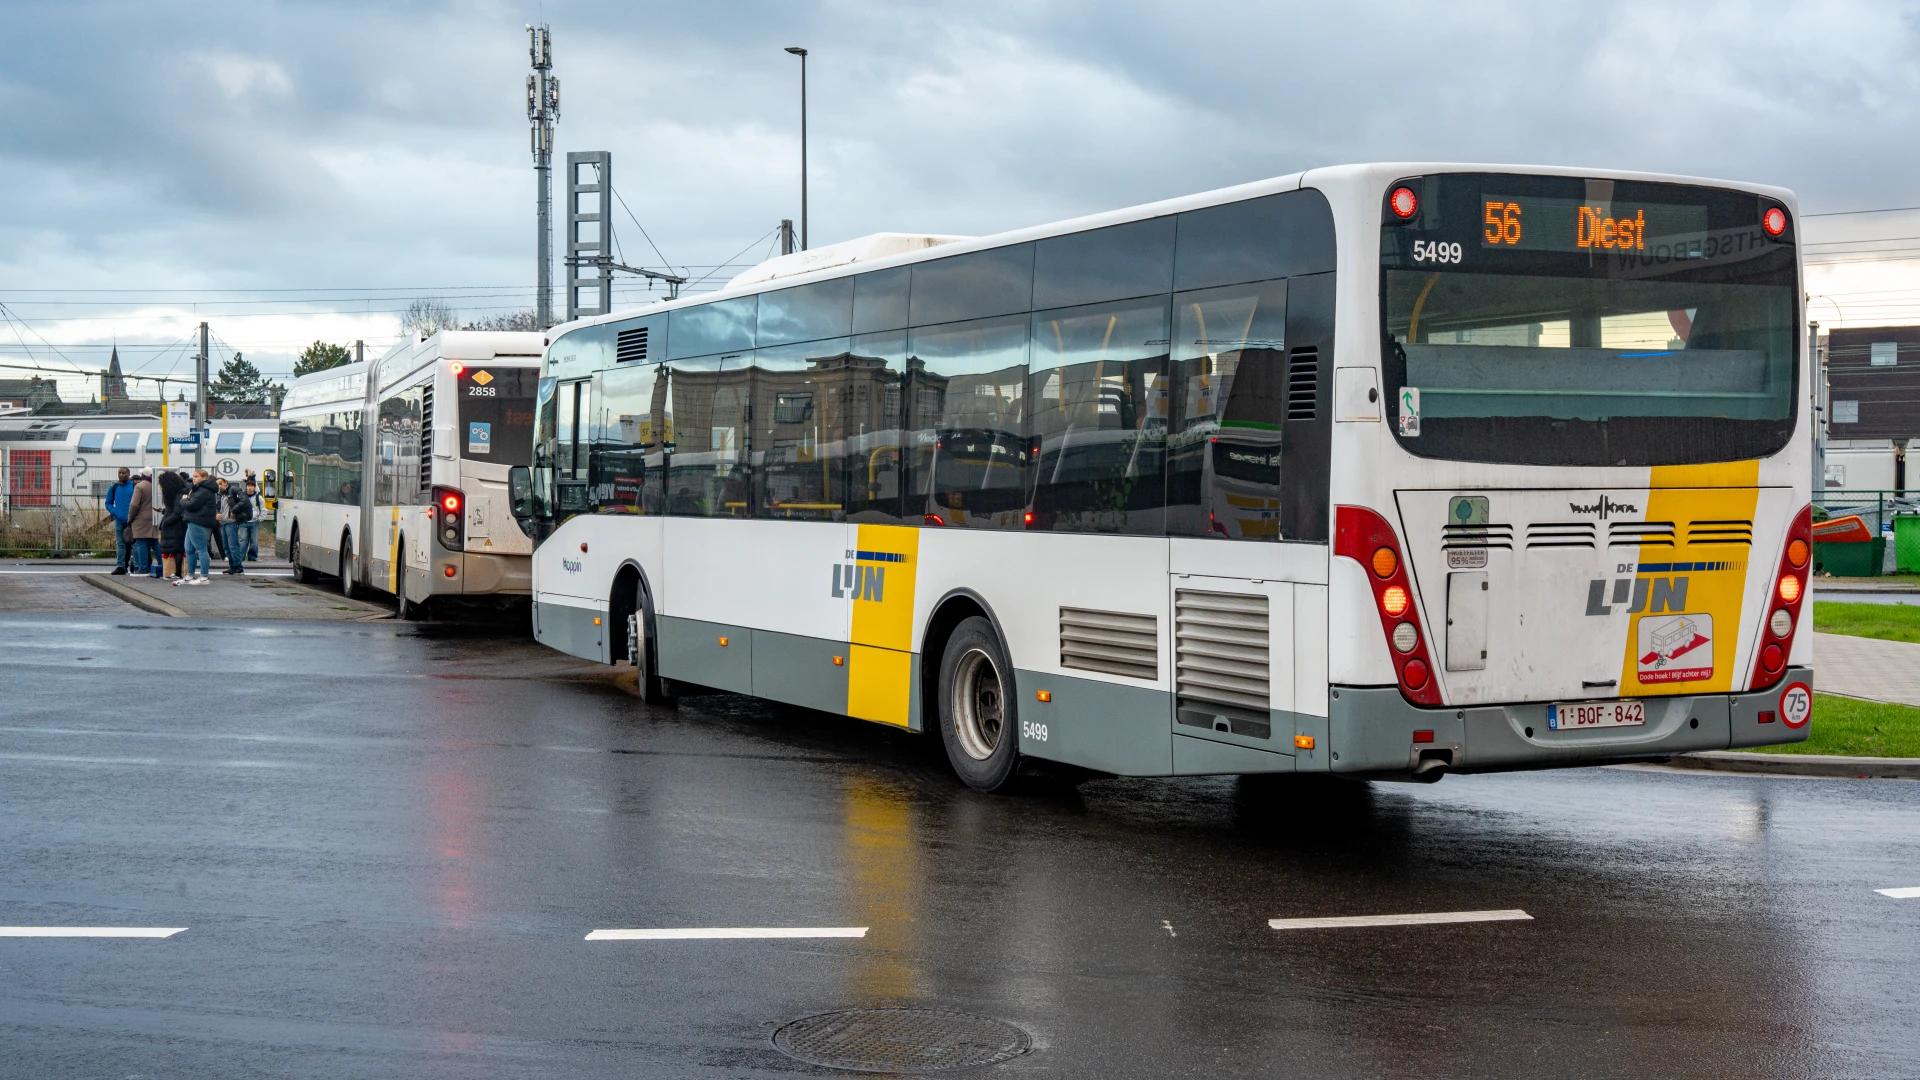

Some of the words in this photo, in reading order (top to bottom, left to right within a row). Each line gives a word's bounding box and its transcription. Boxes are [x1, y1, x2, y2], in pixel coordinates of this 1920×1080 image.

[1485, 201, 1522, 245] 56
[1577, 206, 1645, 250] Diest
[1413, 240, 1462, 264] 5499
[469, 386, 496, 397] 2858
[222, 460, 234, 474] B
[845, 549, 855, 559] DE
[562, 556, 582, 575] Hoppin
[1616, 563, 1634, 574] DE
[831, 563, 885, 603] LIJN
[1585, 577, 1690, 616] LIJN
[1639, 673, 1654, 681] Dode
[1671, 670, 1682, 680] Blijf
[1682, 669, 1699, 678] achter
[1787, 693, 1807, 712] 75
[1023, 720, 1048, 742] 5499
[1549, 718, 1556, 728] B
